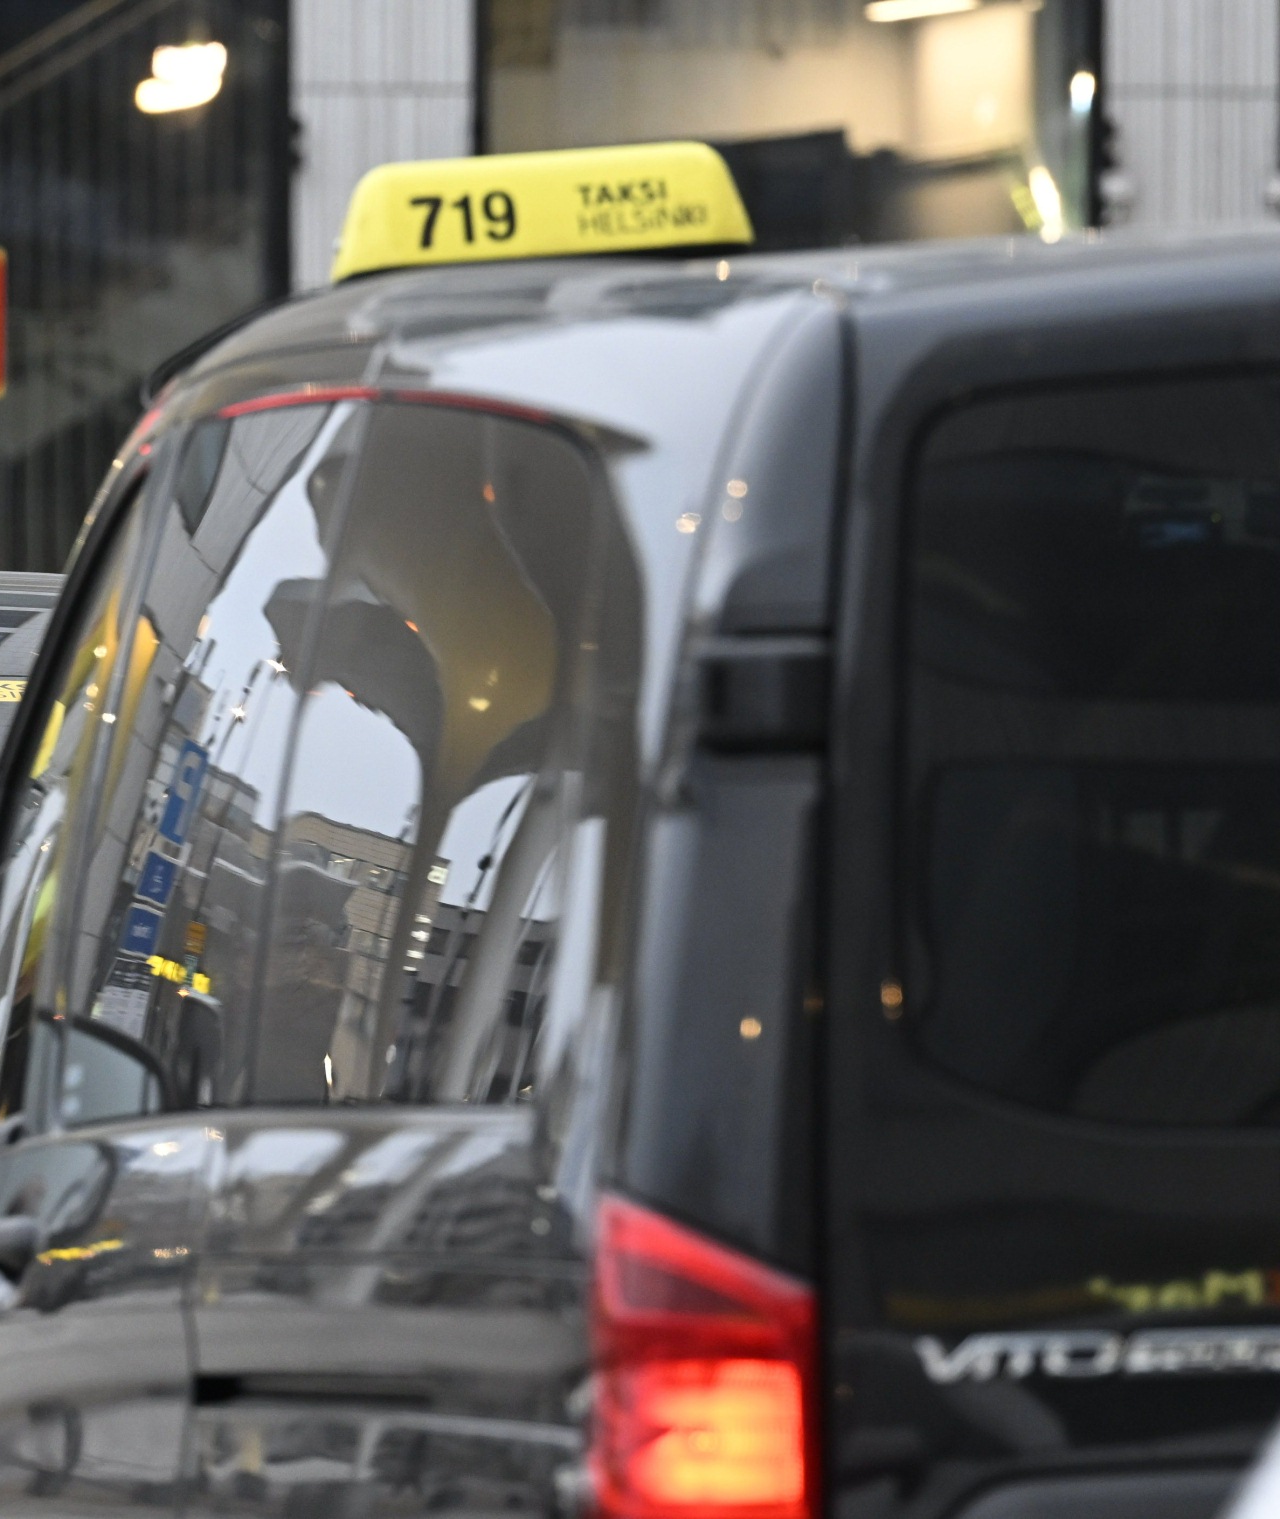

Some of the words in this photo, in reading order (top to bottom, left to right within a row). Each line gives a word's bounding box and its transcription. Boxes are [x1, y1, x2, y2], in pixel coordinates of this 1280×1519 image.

[577, 180, 668, 206] TAKSI
[409, 190, 517, 249] 719
[577, 204, 709, 236] HELSINKI
[914, 1328, 1121, 1384] VITO
